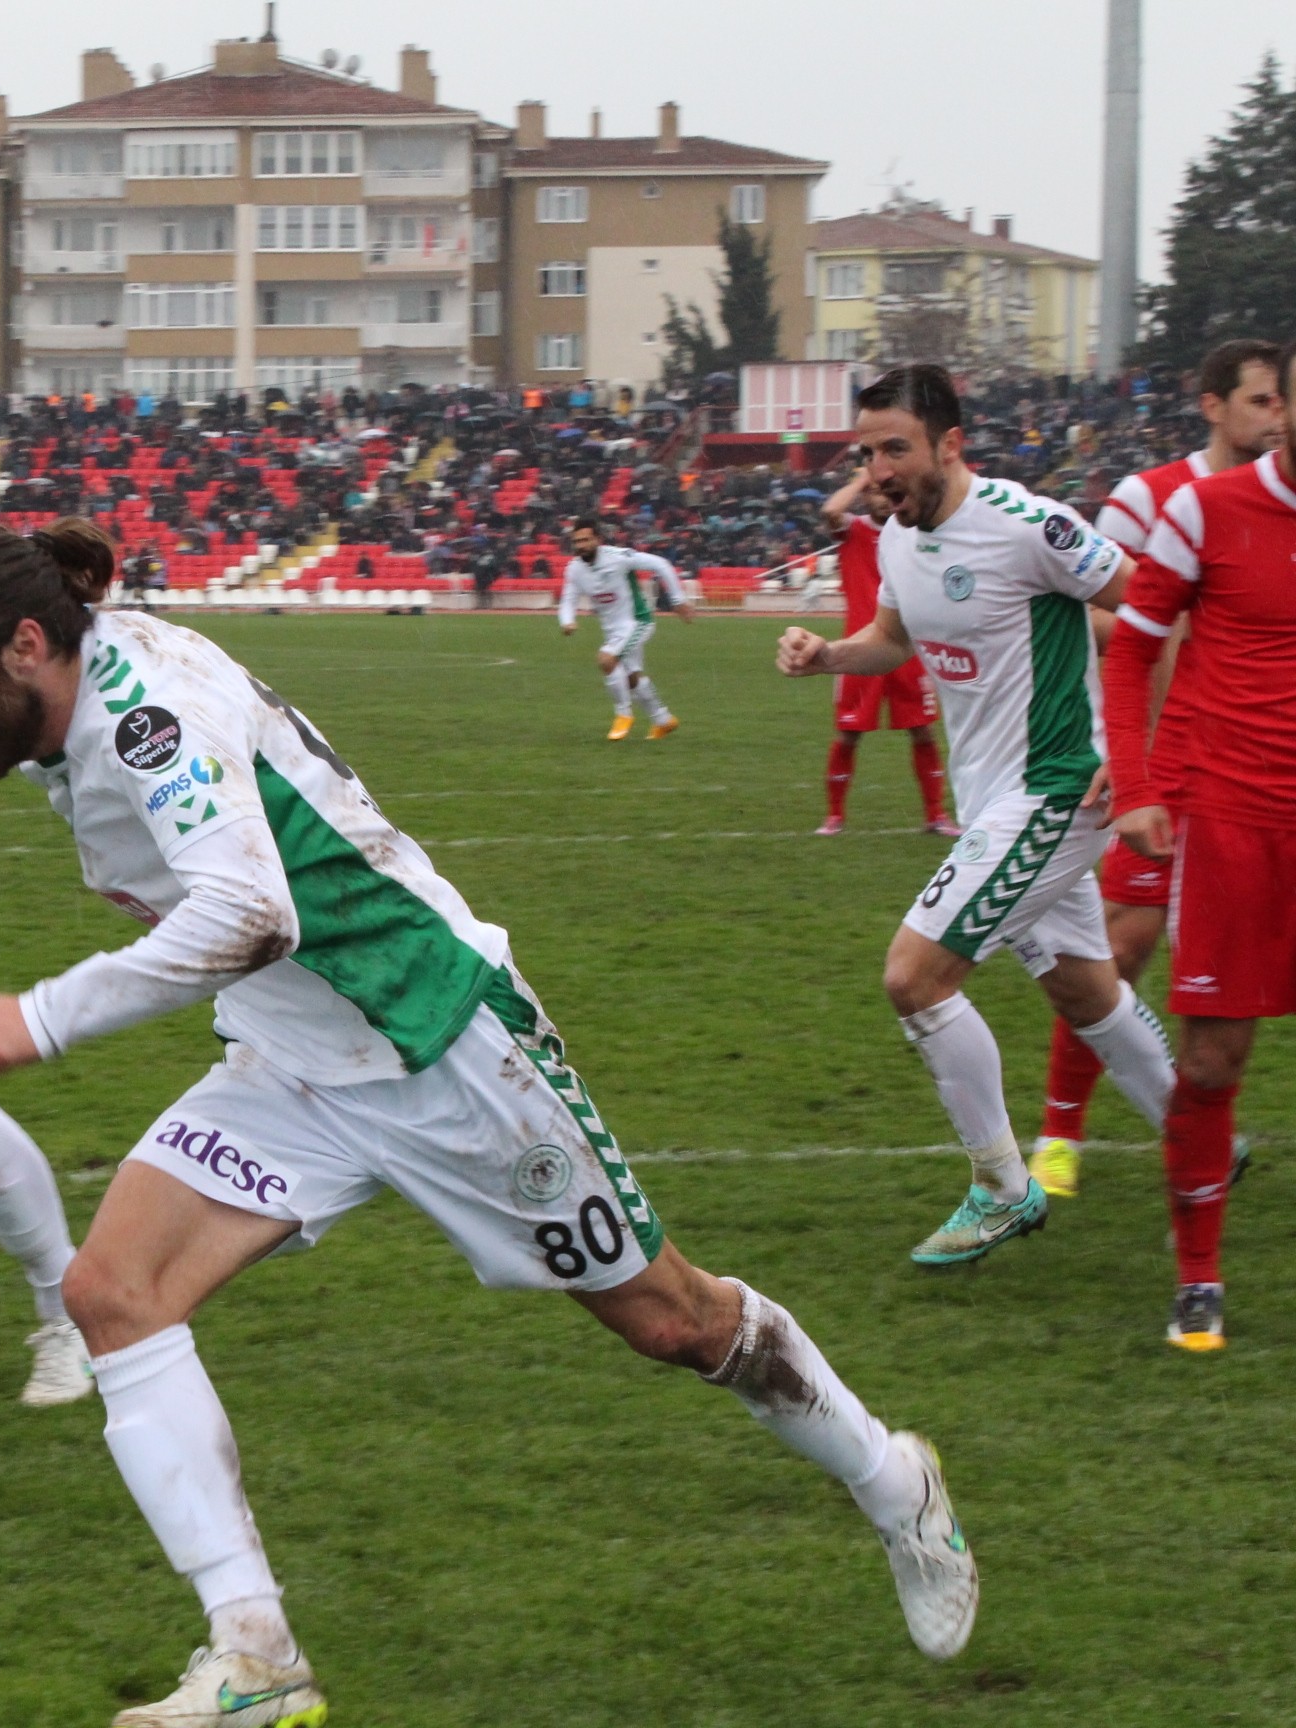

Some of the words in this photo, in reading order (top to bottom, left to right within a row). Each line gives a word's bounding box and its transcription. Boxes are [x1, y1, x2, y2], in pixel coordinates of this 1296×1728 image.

[923, 864, 955, 909] 8
[156, 1121, 287, 1204] adese
[535, 1195, 623, 1279] 80
